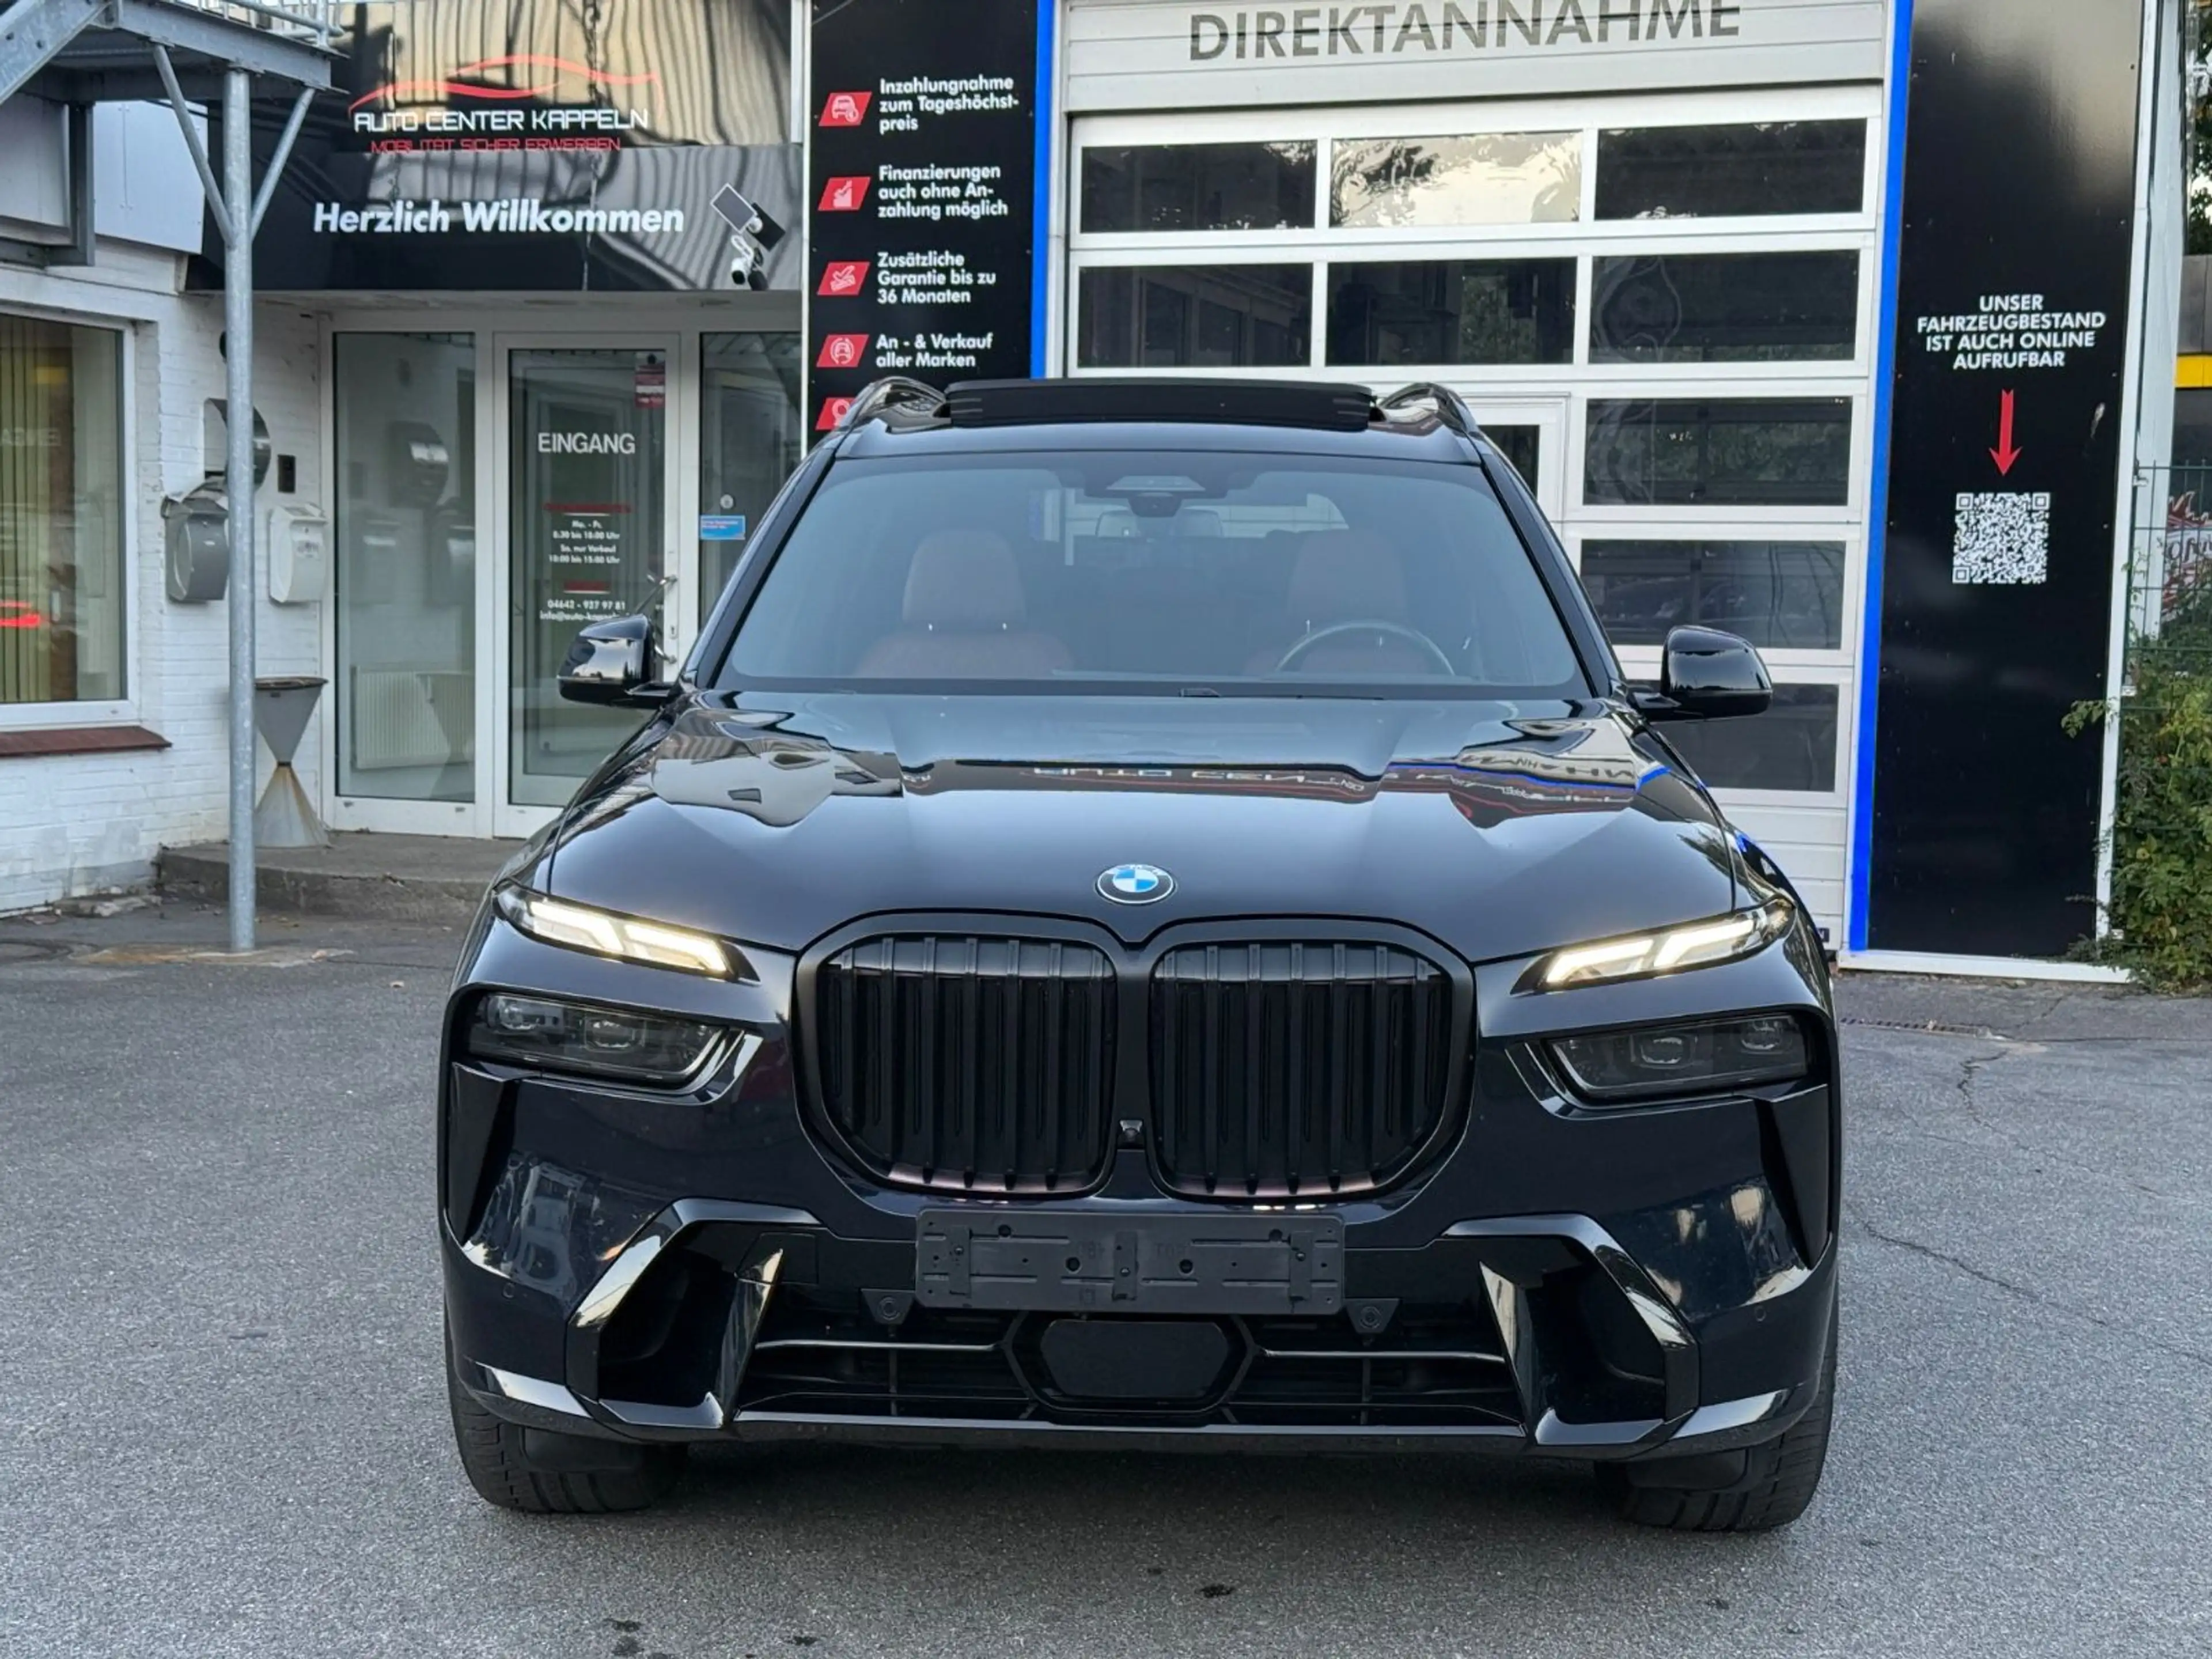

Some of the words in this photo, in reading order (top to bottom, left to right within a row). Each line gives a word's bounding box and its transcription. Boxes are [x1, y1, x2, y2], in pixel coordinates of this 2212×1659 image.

[1190, 0, 1738, 60] DIREKTANNAHME
[880, 74, 1014, 96] Inzahlungnahme
[879, 98, 913, 113] zum
[917, 93, 1019, 115] Tageshöchst-
[354, 112, 419, 132] AUTO
[426, 110, 524, 131] CENTER
[532, 108, 649, 131] KAPPELN
[879, 115, 919, 135] preis
[371, 136, 455, 153] MOBIITÄT
[460, 137, 520, 153] SICHER
[525, 137, 621, 152] ERWERBEN
[878, 164, 1001, 183] Finanzierungen
[878, 184, 916, 199] auch
[921, 183, 961, 198] ohne
[964, 183, 994, 198] An-
[313, 202, 449, 233] Herzlich
[461, 199, 684, 233] Willkommen
[878, 202, 941, 221] zahlung
[945, 199, 1009, 220] möglich
[877, 250, 965, 267] Zusätzliche
[877, 269, 946, 286] Garantie
[950, 270, 974, 285] bis
[978, 274, 997, 285] zu
[877, 289, 897, 304] 36
[902, 289, 971, 304] Monaten
[1979, 294, 2044, 312] UNSER
[1917, 312, 2107, 333] FAHRZEUGBESTAND
[914, 334, 927, 350] &
[930, 332, 994, 349] Verkauf
[1926, 334, 1953, 351] IST
[1957, 332, 2014, 351] AUCH
[2020, 331, 2096, 349] ONLINE
[876, 354, 912, 368] aller
[915, 351, 976, 368] Marken
[1953, 350, 2066, 370] AUFRUFBAR
[537, 432, 636, 454] EINGANG
